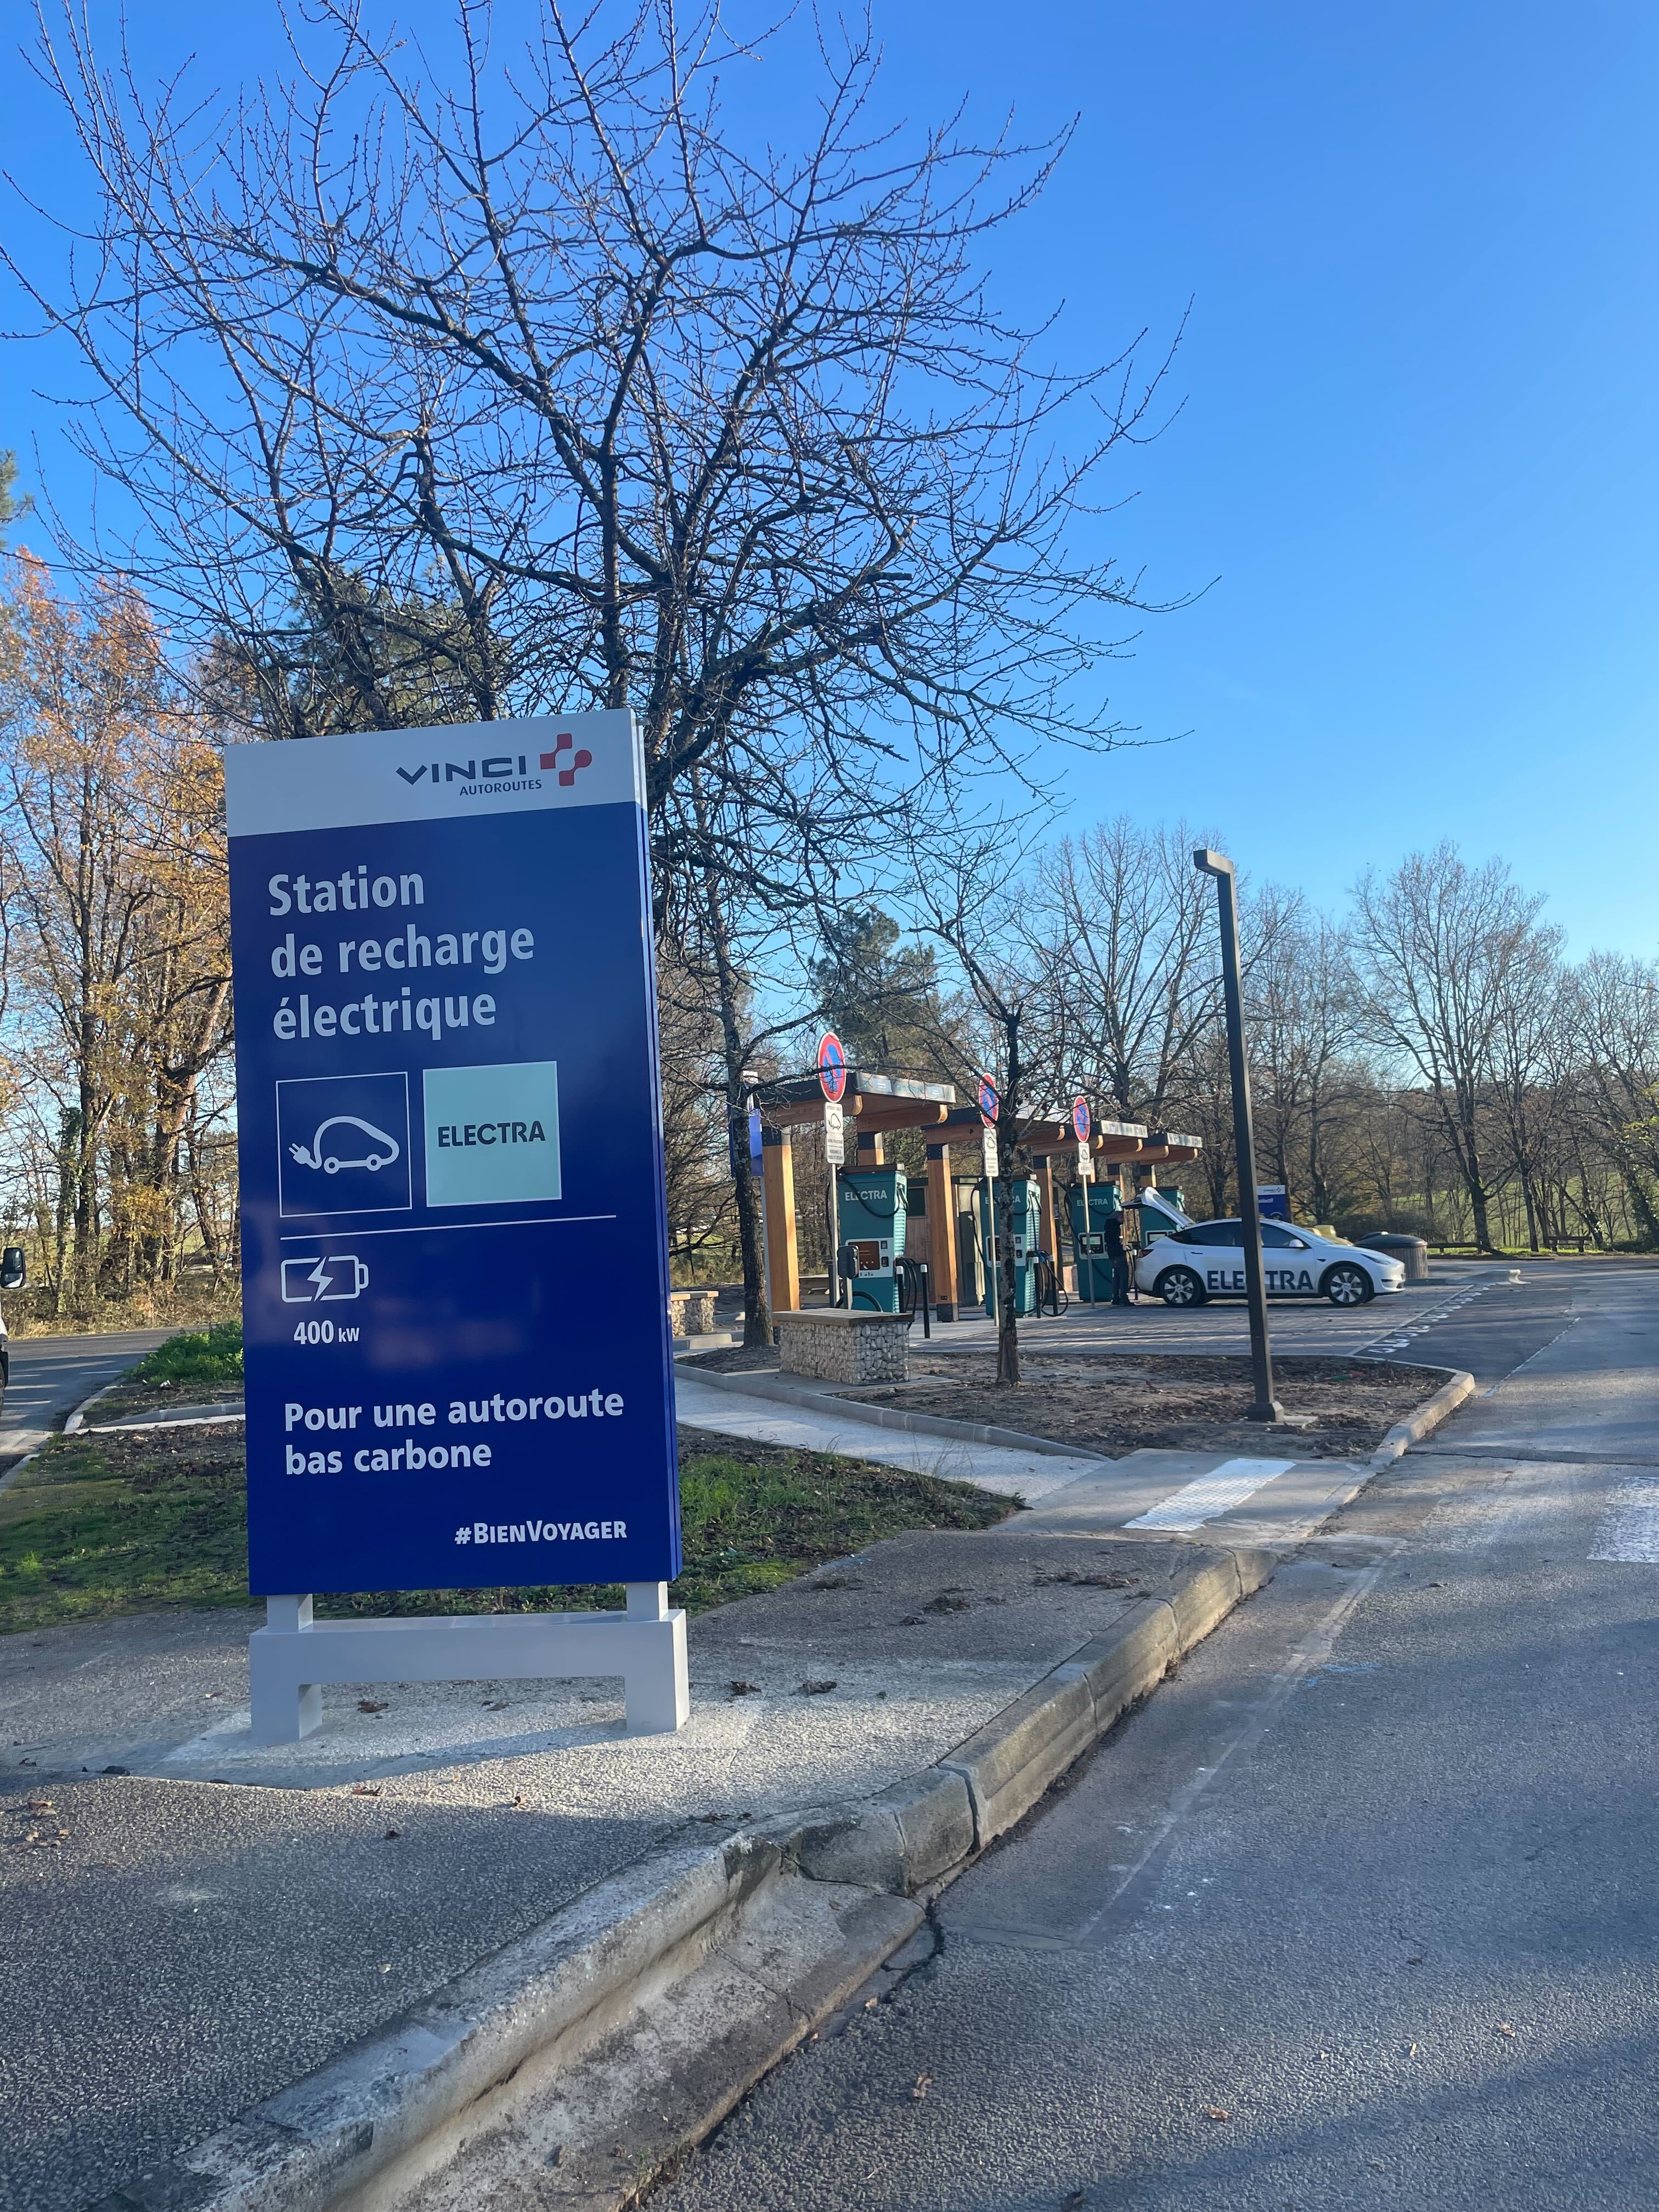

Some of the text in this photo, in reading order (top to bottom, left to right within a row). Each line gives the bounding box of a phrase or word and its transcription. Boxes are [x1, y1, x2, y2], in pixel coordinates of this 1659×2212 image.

[396, 755, 526, 785] VINCI
[459, 779, 542, 796] AUTOROUTES
[268, 865, 424, 916] Station
[271, 923, 534, 978] de recharge
[273, 986, 496, 1041] électrique
[438, 1120, 546, 1148] ELECTRA
[1076, 1198, 1108, 1206] ELCTRA
[1207, 1270, 1313, 1290] ELETRA
[294, 1320, 360, 1345] 400 kW
[285, 1388, 624, 1431] Pour une autoroute
[286, 1438, 492, 1475] bas carbone
